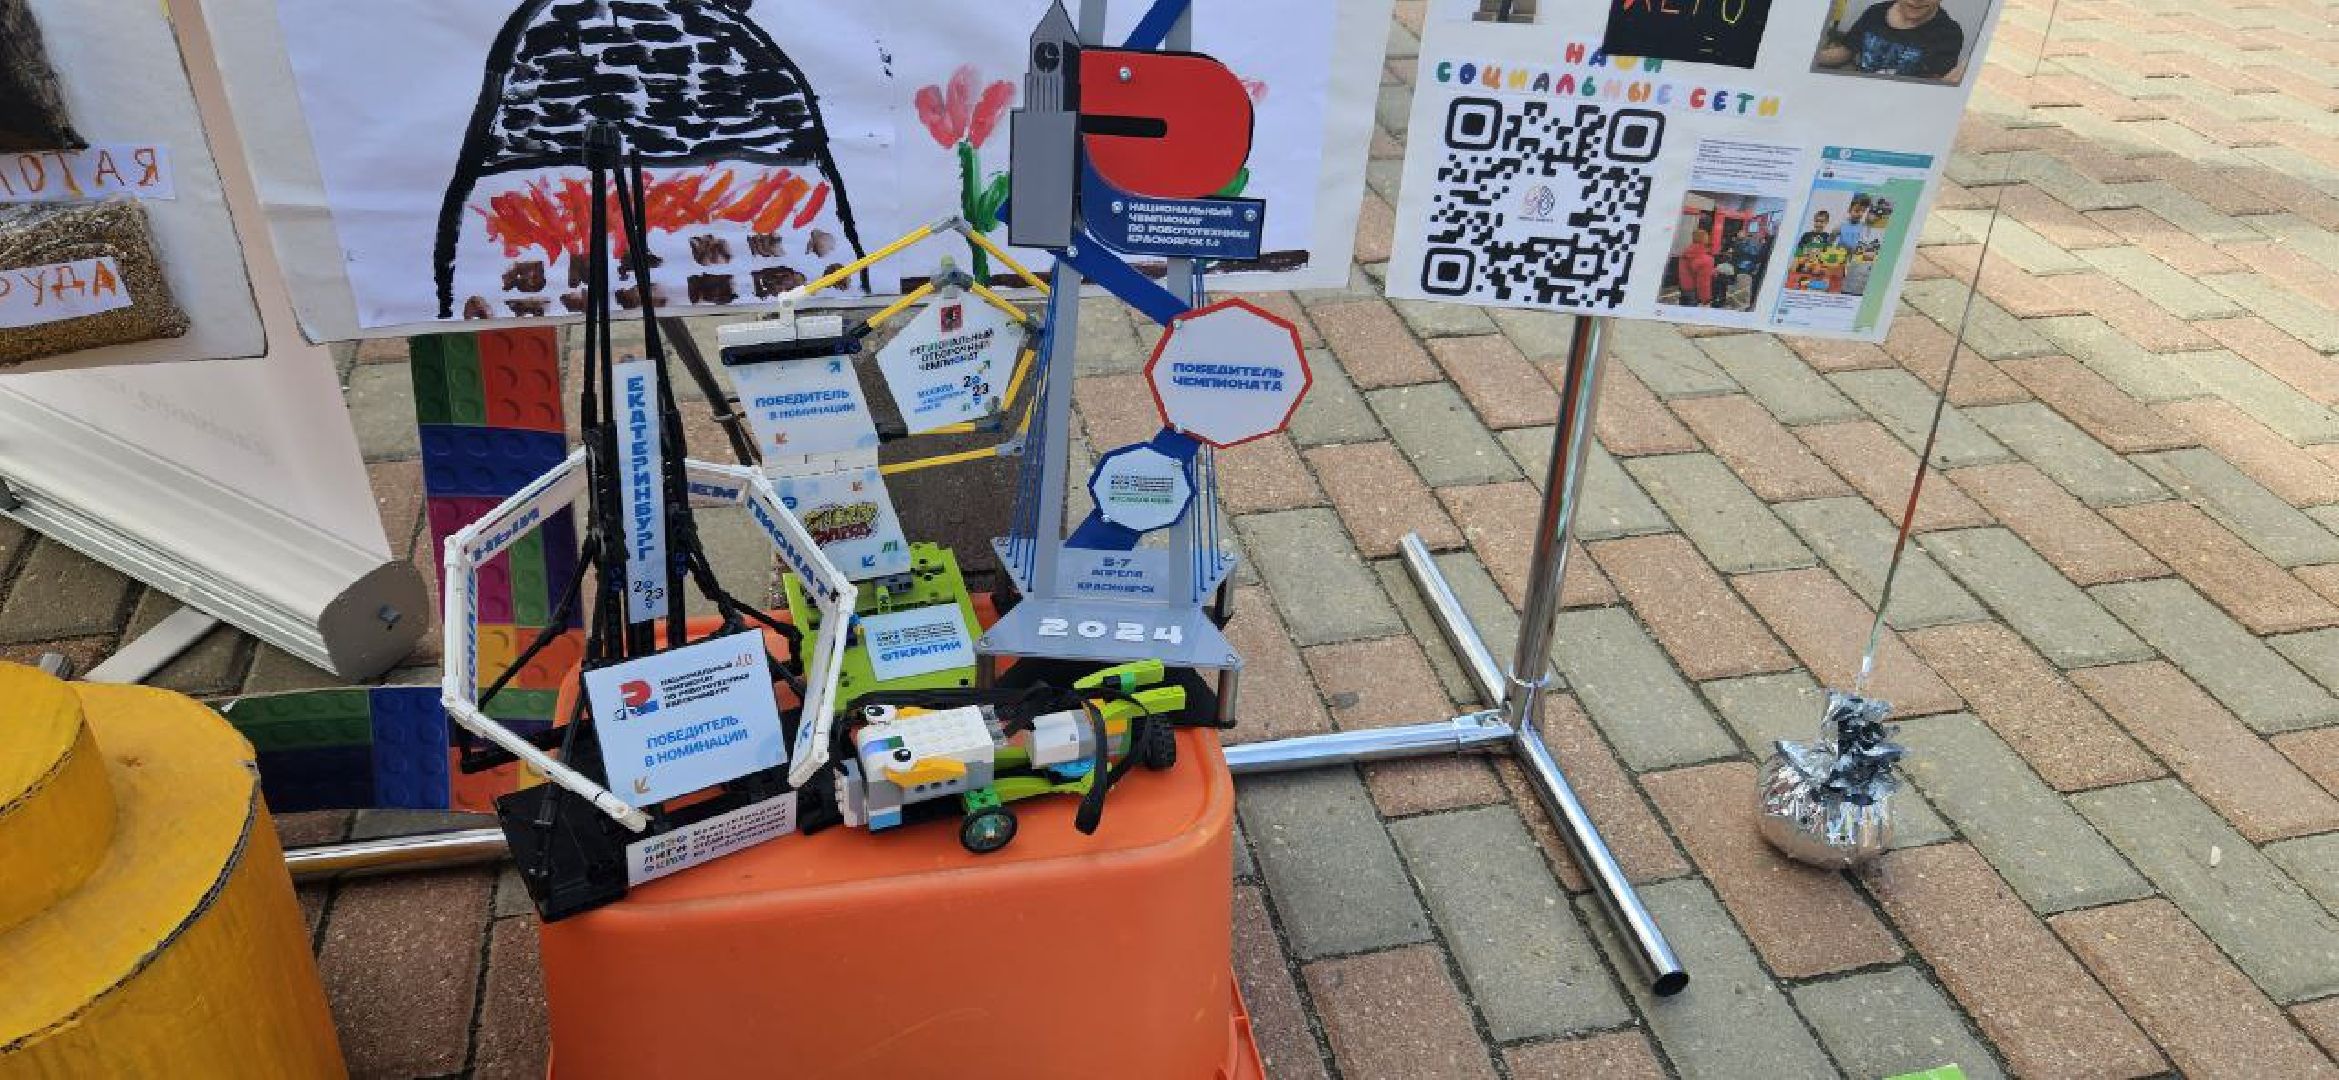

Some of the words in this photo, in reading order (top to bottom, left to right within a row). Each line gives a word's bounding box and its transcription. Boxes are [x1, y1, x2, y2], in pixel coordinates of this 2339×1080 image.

[1436, 61, 1673, 105] СОЦИАЛЬНЫЕ
[1689, 87, 1780, 116] СЕТИ
[1128, 202, 1233, 217] НАЦИОНАЛЬНЫЙ
[1128, 213, 1203, 225] ЧЕМПИОНАТ
[1128, 223, 1144, 233] ПО
[1148, 225, 1250, 238] РОБОТОТЕХНИКЕ
[1127, 234, 1203, 245] КРАСНОЯРСК
[1172, 362, 1285, 378] ПОБЕДИТЕЛЬ
[1172, 375, 1283, 391] ЧЕМПИОНАТА
[755, 389, 850, 408] ПОБЕДИТЕЛЬ
[778, 402, 856, 419] НОМИНАЦИИ
[627, 375, 654, 561] ЕКАТЕРИНБУРГ
[1091, 569, 1144, 579] АПРЕЛЯ
[1077, 581, 1155, 593] КРАСНОЯРСК
[1038, 617, 1183, 645] 2024
[646, 714, 739, 749] ПОБЕДИТЕЛЬ
[644, 755, 655, 768] В
[656, 728, 748, 764] НОМИНАЦИИ
